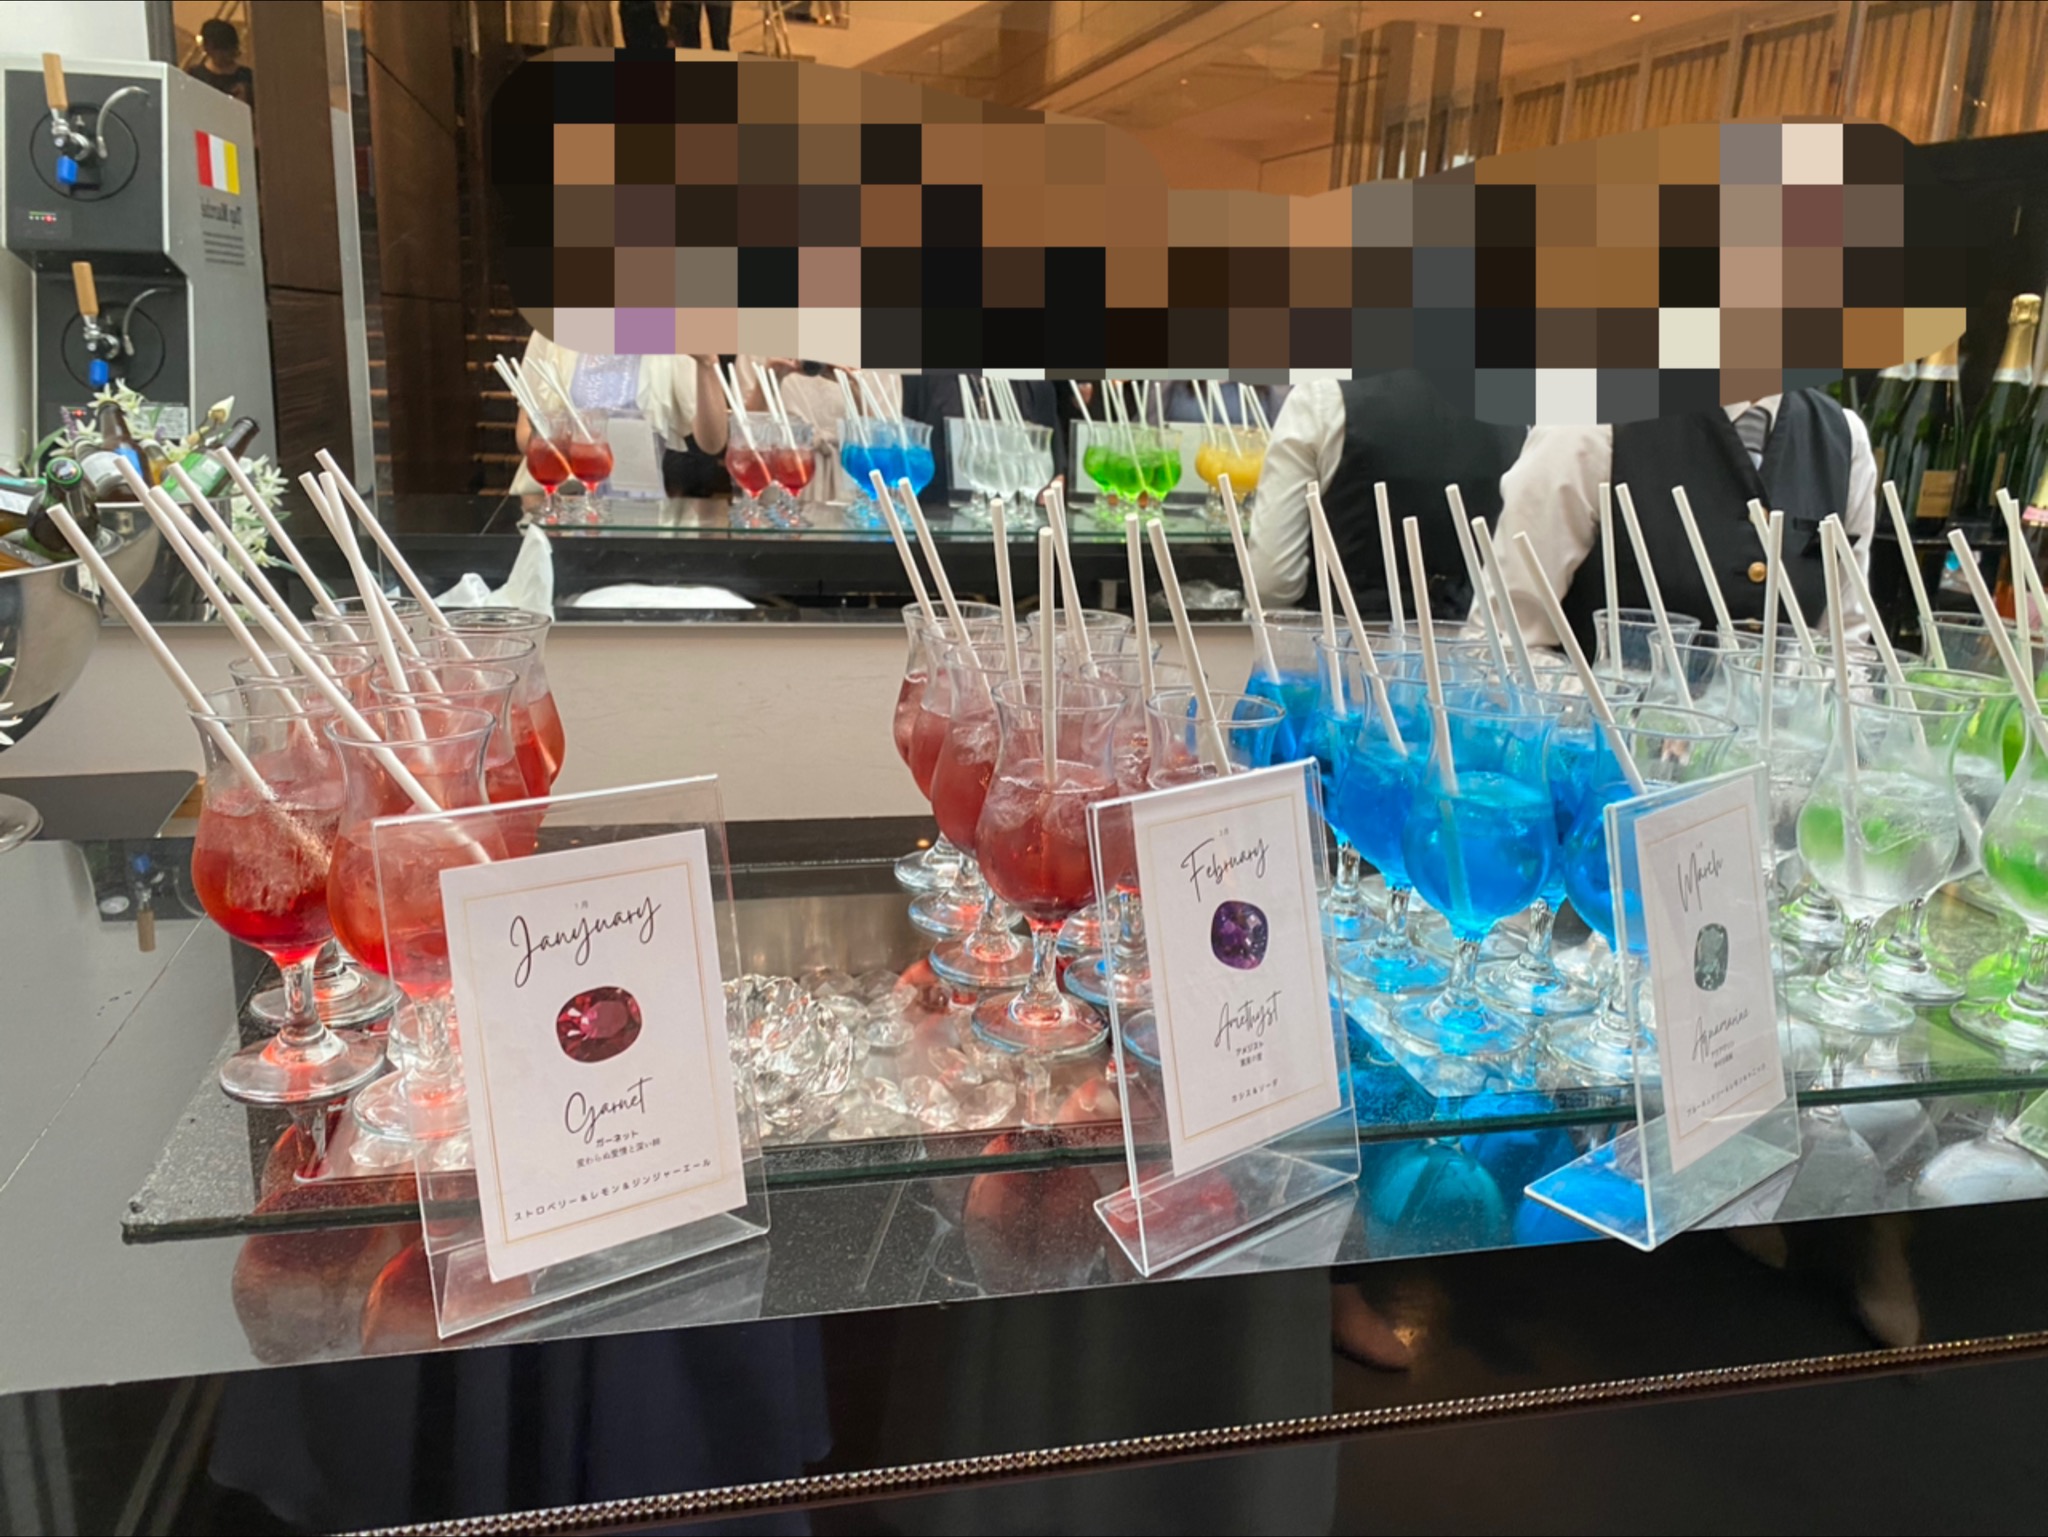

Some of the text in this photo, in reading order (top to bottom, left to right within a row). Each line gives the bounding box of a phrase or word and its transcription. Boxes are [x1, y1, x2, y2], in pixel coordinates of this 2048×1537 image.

[1180, 837, 1270, 903] February
[564, 1077, 653, 1144] Garnet
[595, 1129, 639, 1148] ガーネット
